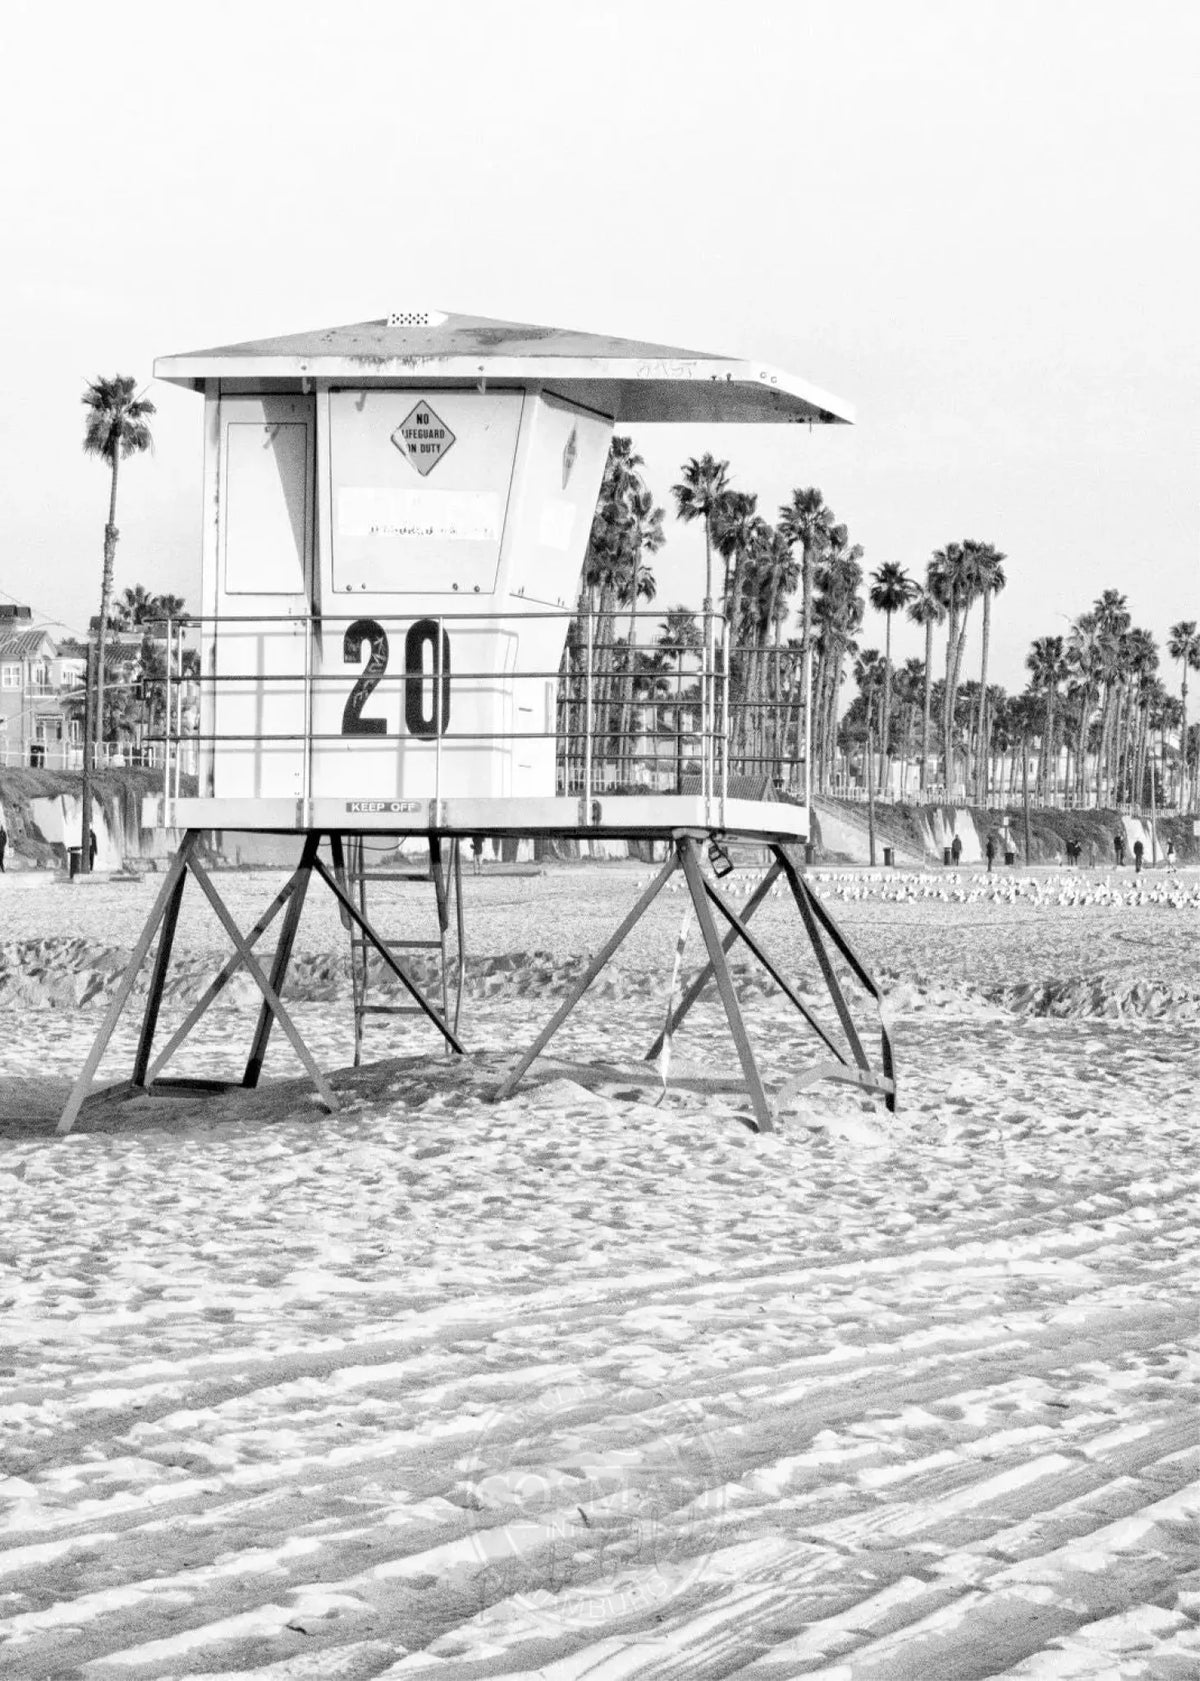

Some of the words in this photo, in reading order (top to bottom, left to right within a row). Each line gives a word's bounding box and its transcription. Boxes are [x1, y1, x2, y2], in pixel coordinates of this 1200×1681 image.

[416, 413, 429, 424] NO
[420, 444, 440, 453] DUTY
[341, 617, 451, 741] 20
[351, 803, 385, 812] KEEP
[390, 803, 416, 812] OFF
